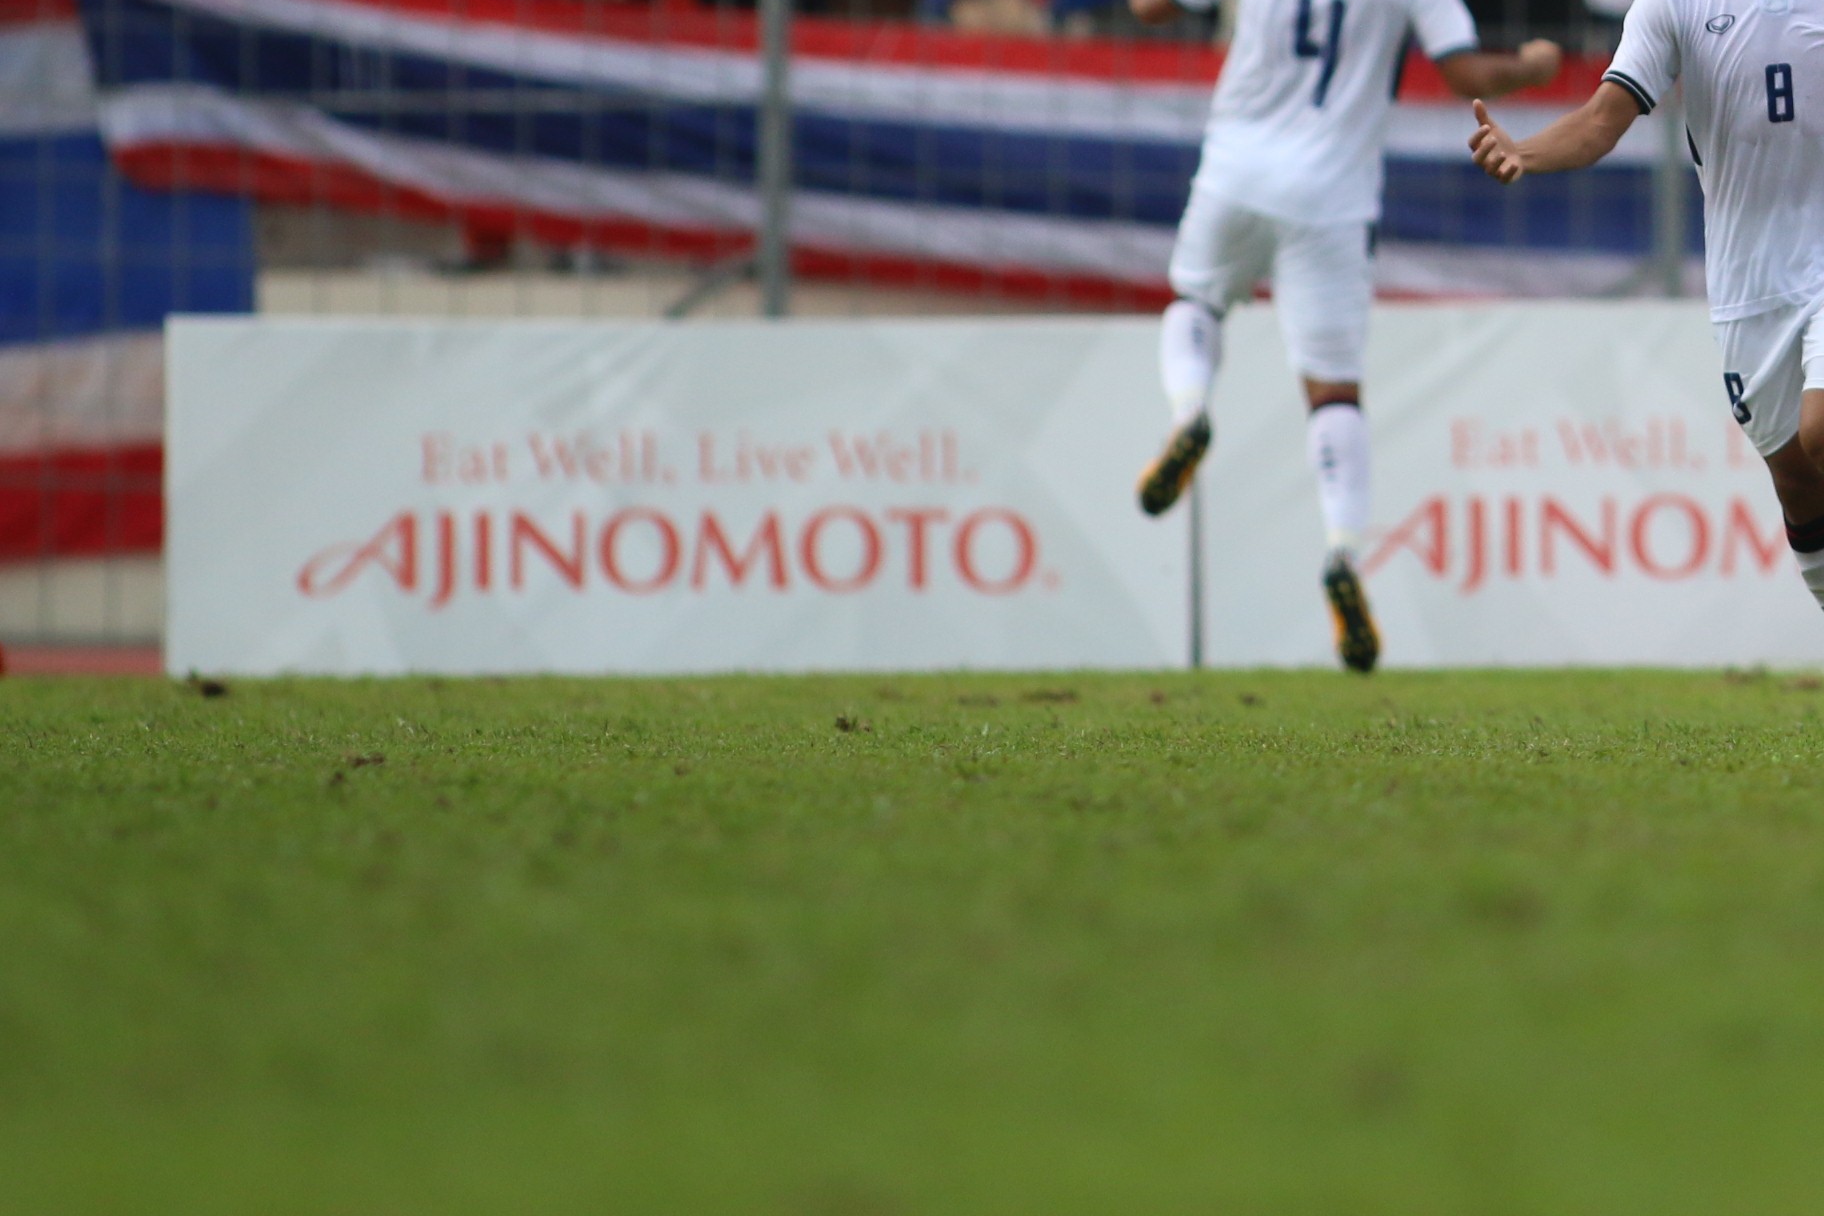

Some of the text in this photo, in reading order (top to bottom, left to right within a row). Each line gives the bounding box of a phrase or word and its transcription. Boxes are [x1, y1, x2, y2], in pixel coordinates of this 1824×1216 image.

[1765, 63, 1794, 123] 8
[422, 429, 979, 487] Eat Well, Live Well.
[1451, 419, 1539, 468] Eat
[297, 503, 1039, 611] AJINOMOTO
